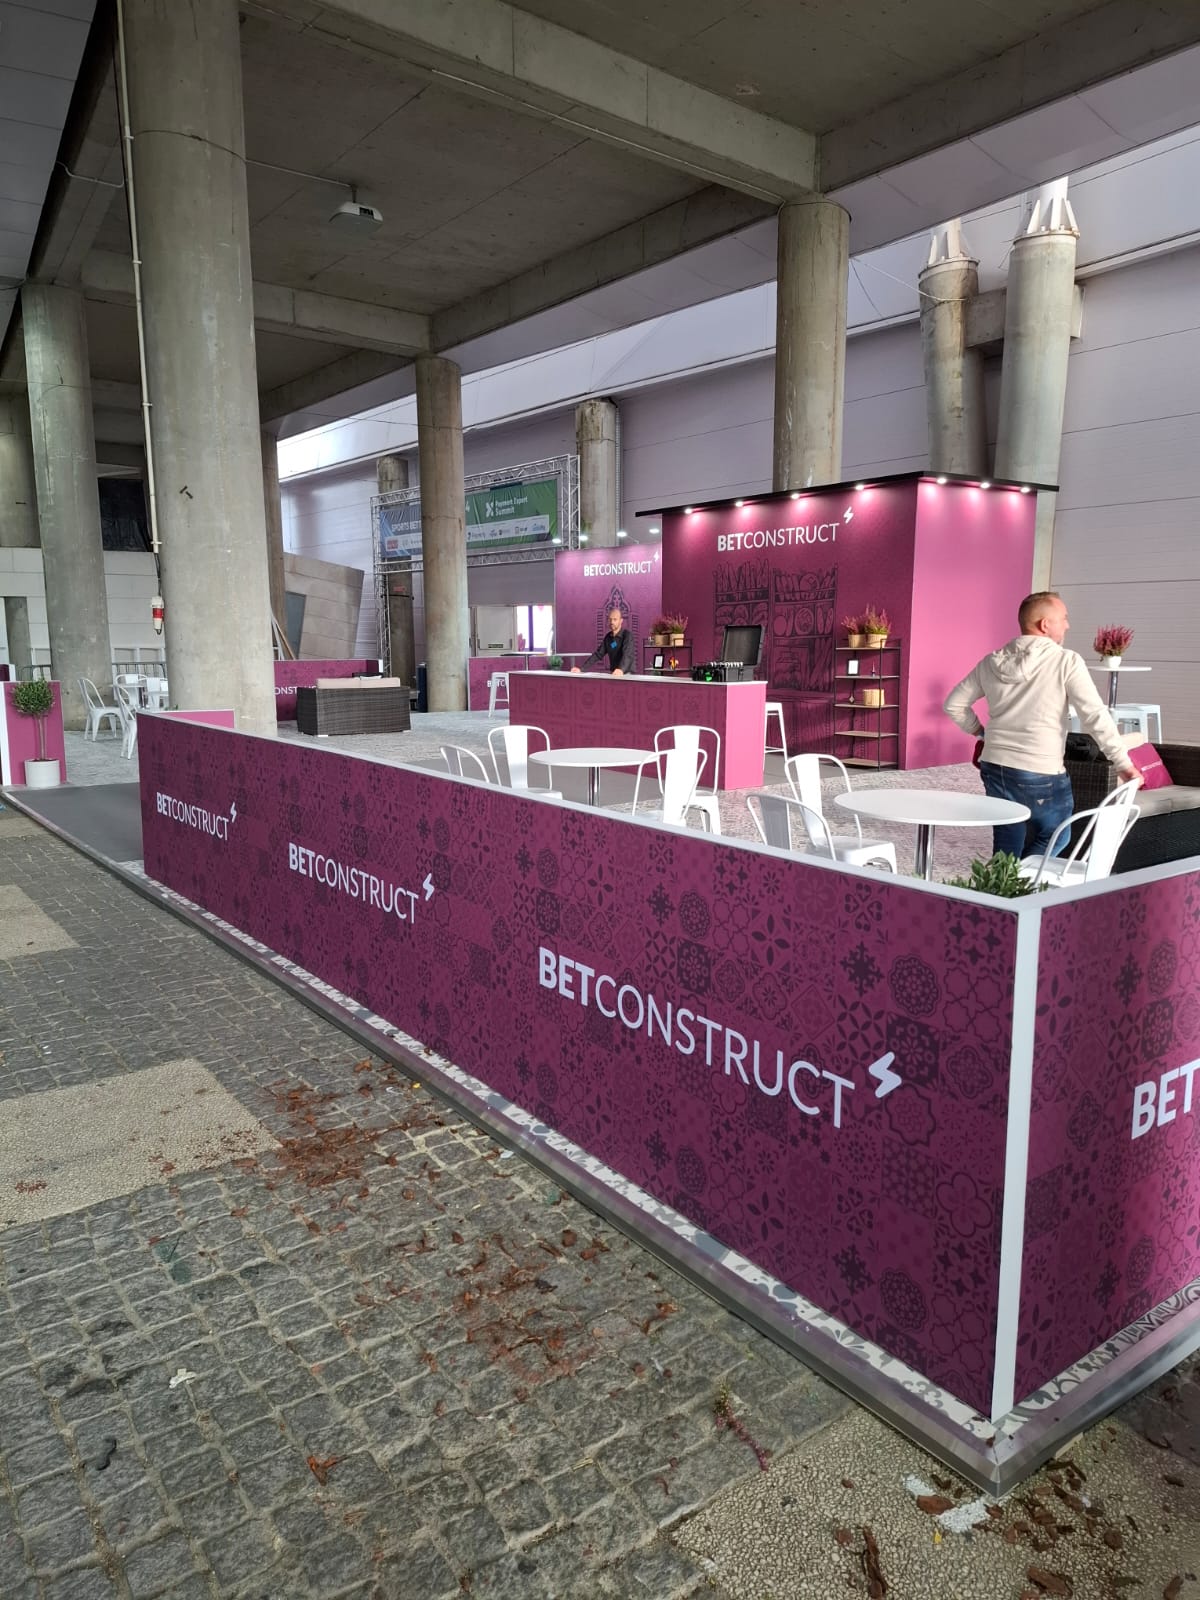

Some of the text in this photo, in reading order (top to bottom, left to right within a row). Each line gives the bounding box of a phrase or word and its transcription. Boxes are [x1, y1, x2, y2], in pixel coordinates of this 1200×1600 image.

[717, 522, 839, 552] BETCONSTRUCT
[583, 561, 652, 577] BETCONSTRUCT
[156, 791, 231, 841] BETCONSTRUCT
[288, 842, 419, 924] BETCONSTRUCT
[538, 946, 856, 1129] BETCONSTRUCT
